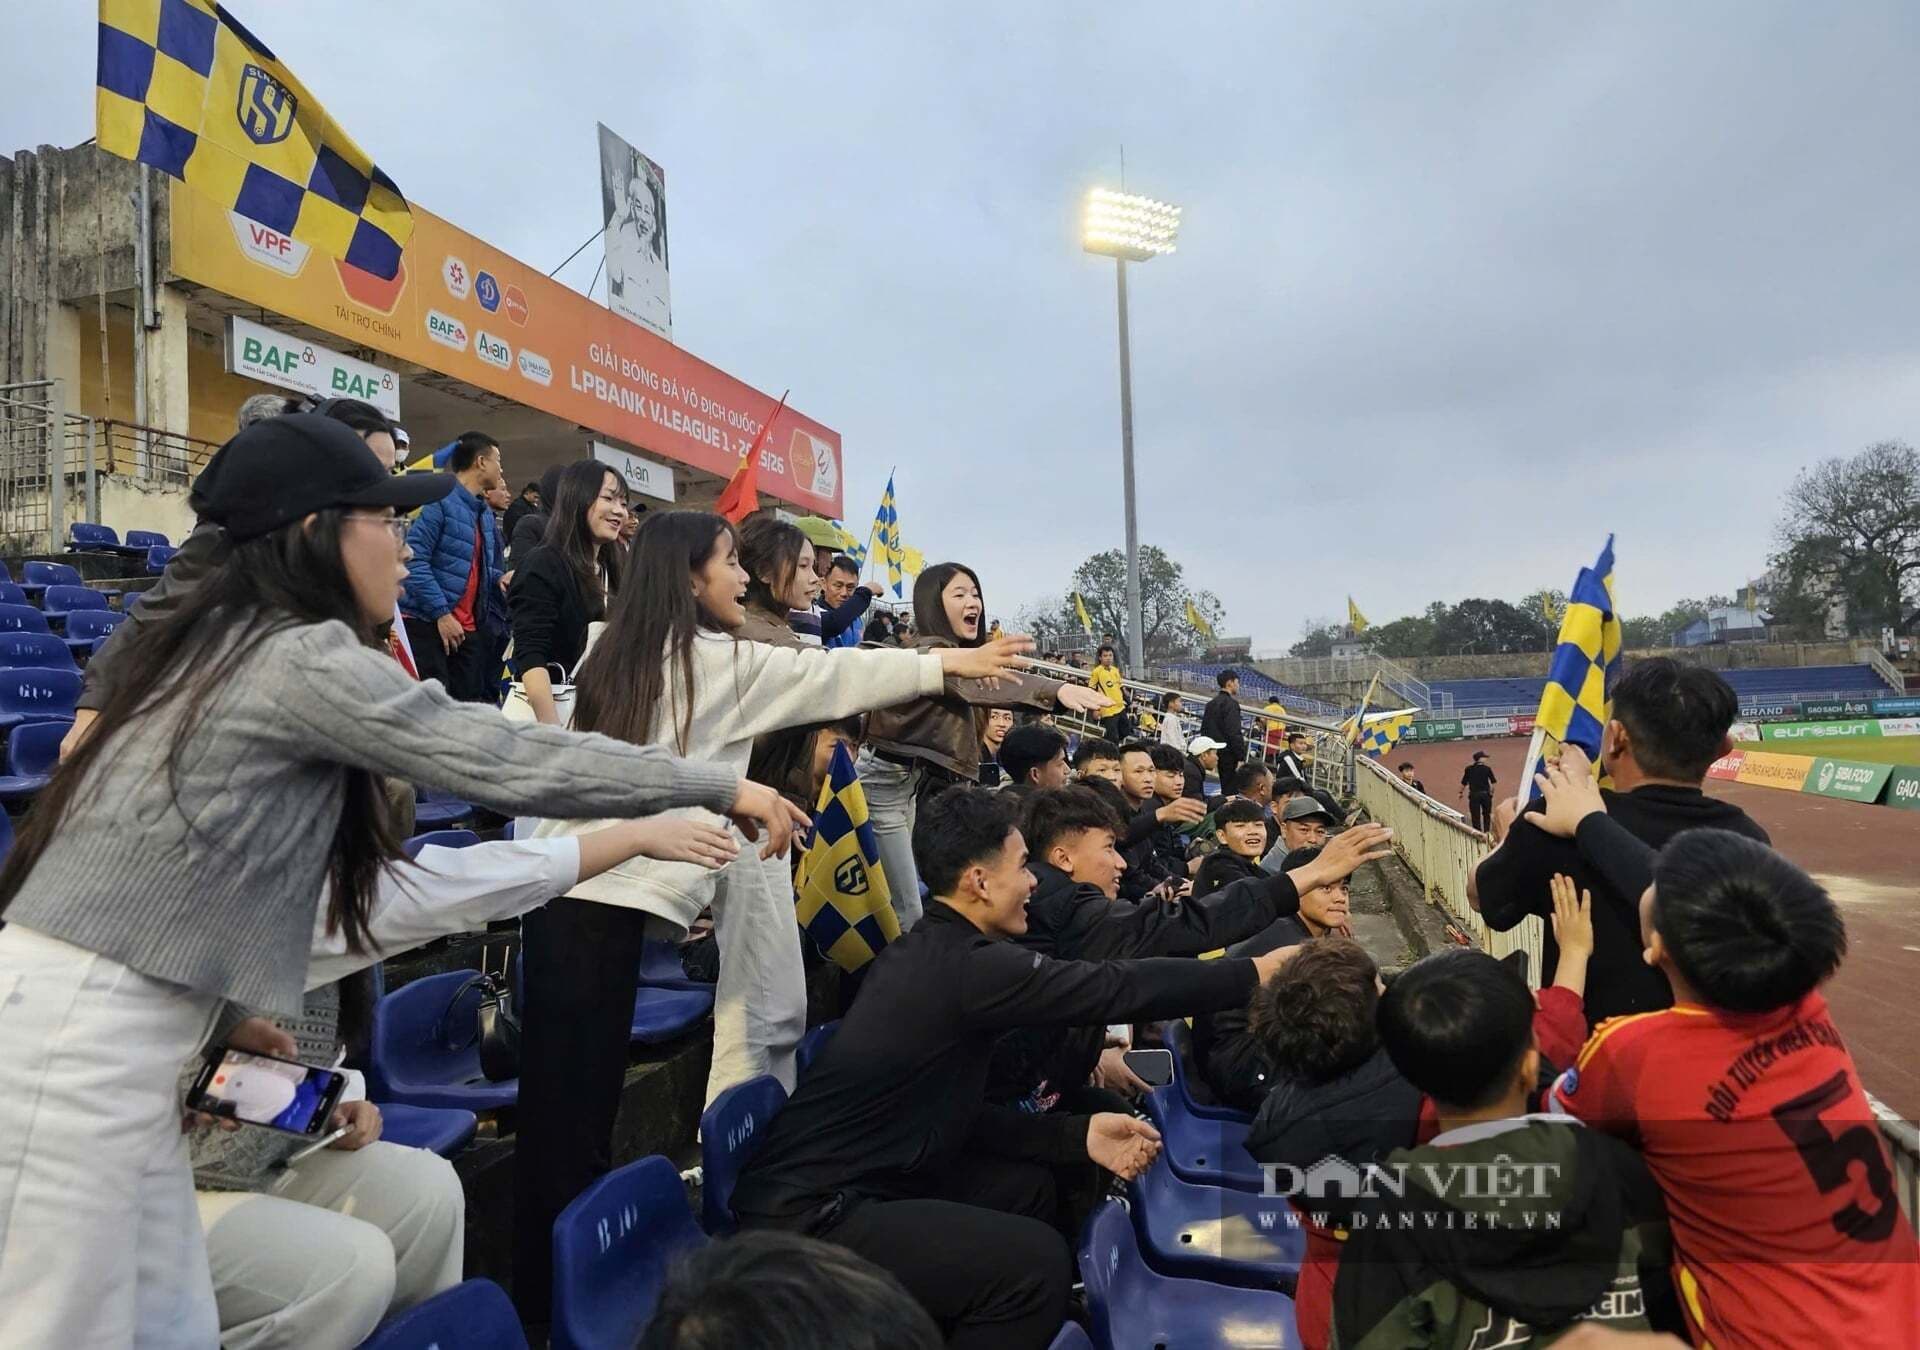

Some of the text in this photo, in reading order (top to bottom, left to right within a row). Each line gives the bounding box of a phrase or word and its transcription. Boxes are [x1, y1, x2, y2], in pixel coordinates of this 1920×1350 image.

[250, 224, 291, 255] VPF
[430, 316, 454, 335] BAF
[243, 337, 299, 374] BAF
[331, 367, 380, 399] BAF
[589, 343, 618, 372] GIẢI
[622, 359, 659, 390] BÓNG
[661, 378, 679, 400] ĐÁ
[681, 387, 698, 408] VÔ
[571, 365, 647, 417] LPBANK
[649, 400, 721, 449] V.LEAGUE
[722, 431, 730, 453] 1
[1741, 706, 1783, 717] GRAND
[1895, 779, 1917, 801] GẠO
[1770, 1069, 1898, 1243] 5
